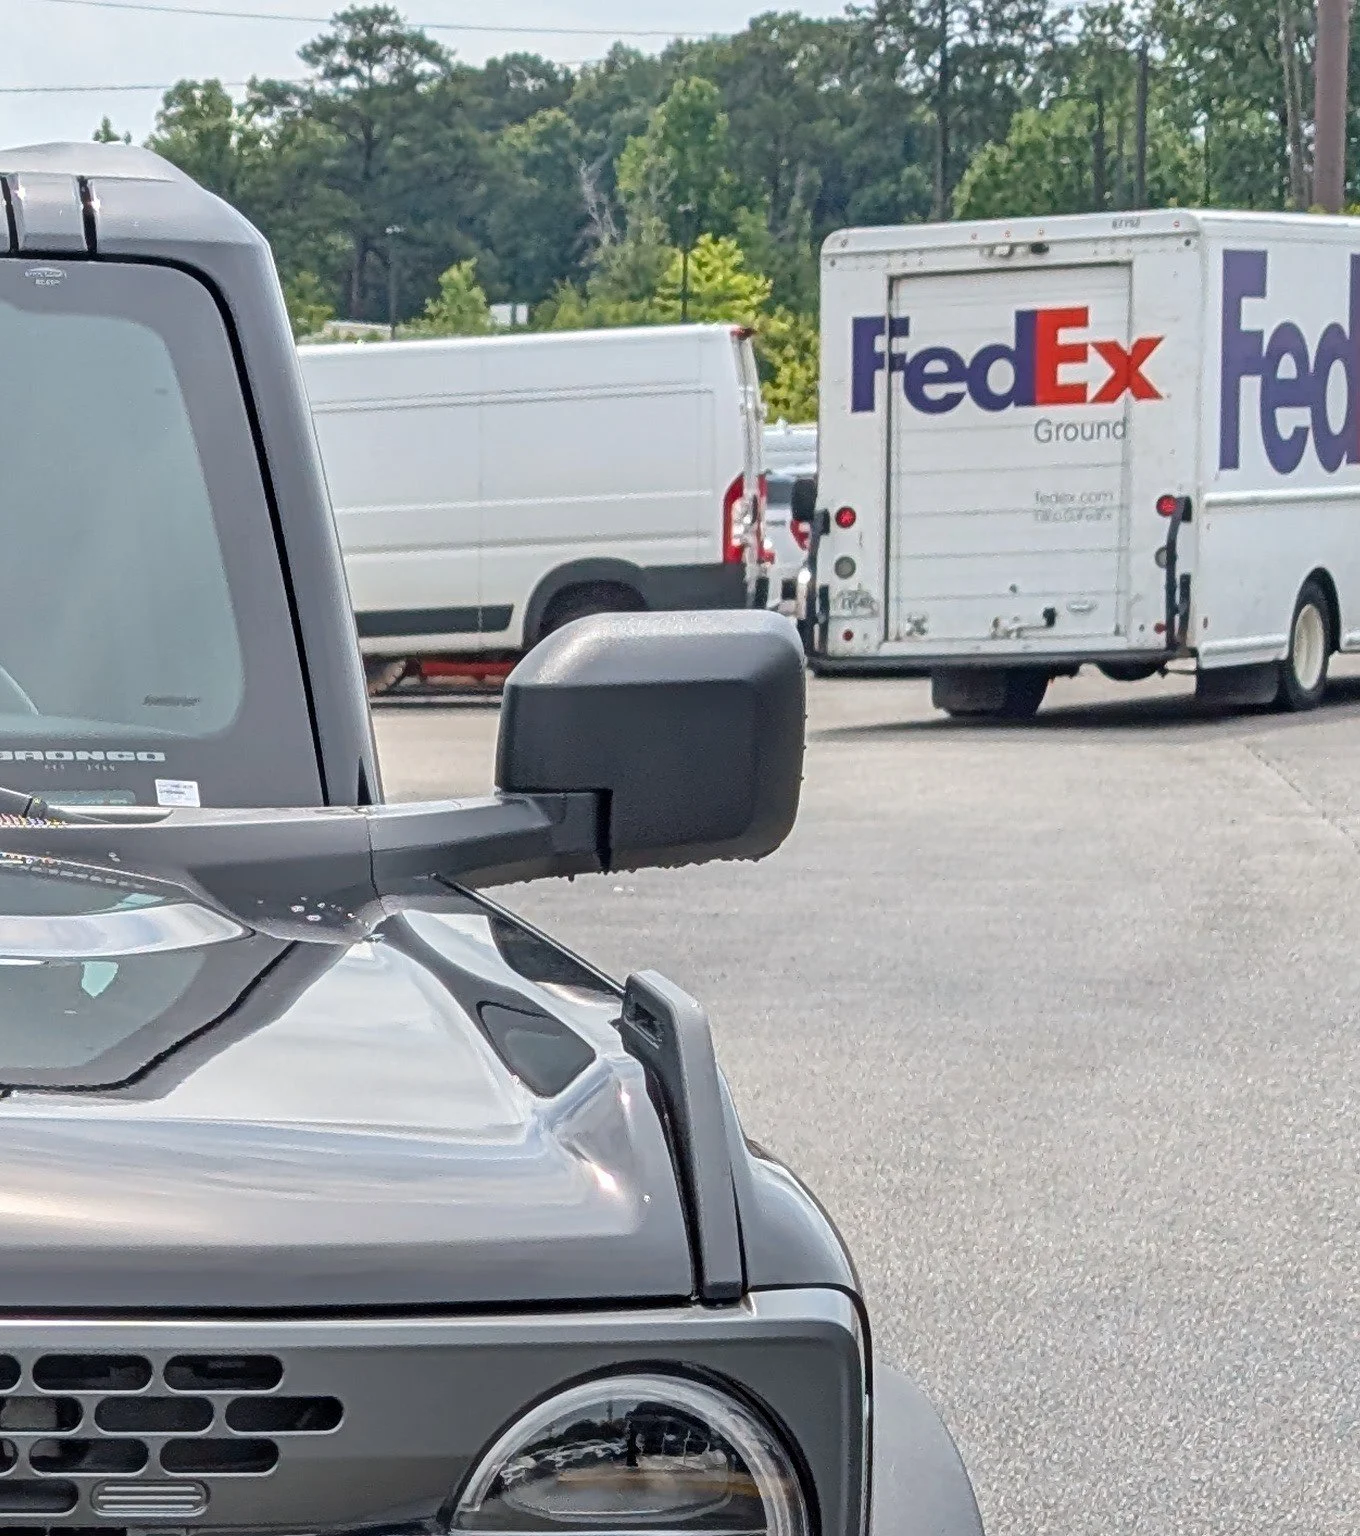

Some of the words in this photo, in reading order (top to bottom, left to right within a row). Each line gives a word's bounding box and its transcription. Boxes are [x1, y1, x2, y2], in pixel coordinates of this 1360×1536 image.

[851, 306, 1164, 414] FedEx
[1219, 250, 1360, 475] Fed
[1034, 417, 1127, 443] Ground
